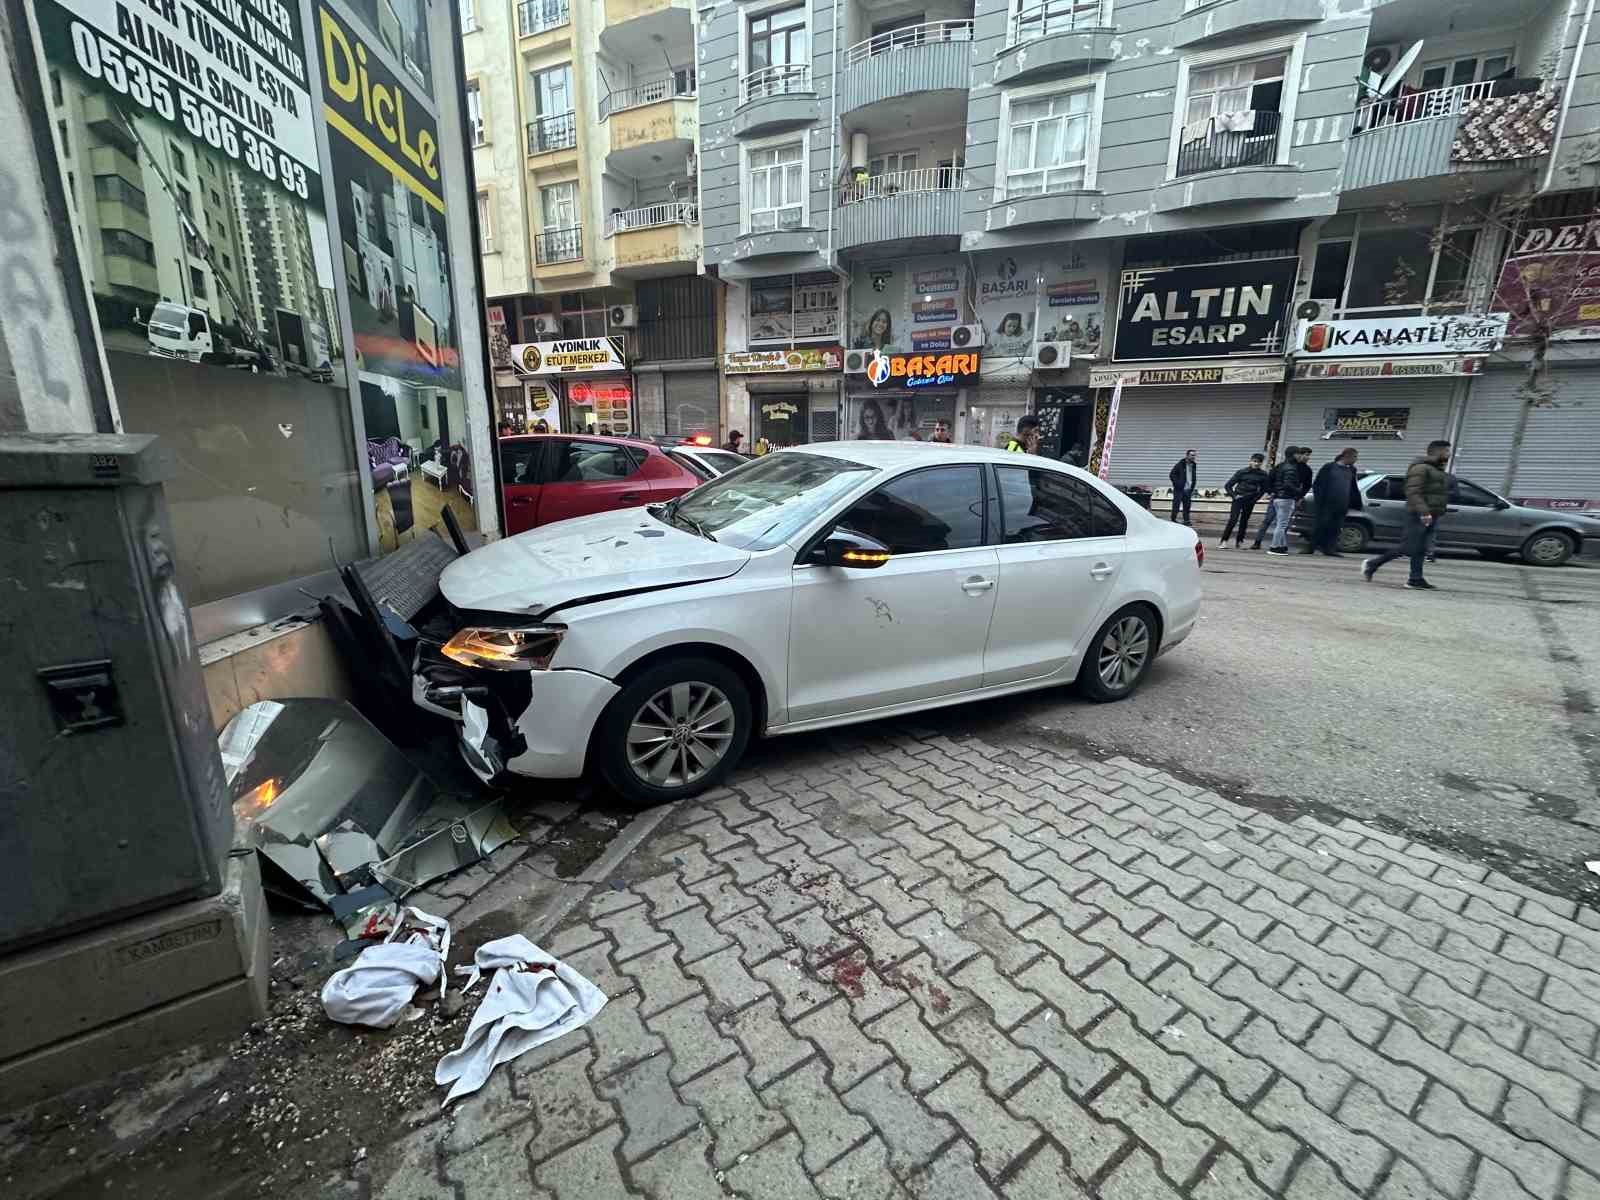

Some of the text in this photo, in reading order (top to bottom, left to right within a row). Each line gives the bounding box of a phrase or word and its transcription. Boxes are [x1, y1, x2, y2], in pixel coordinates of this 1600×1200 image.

[115, 1, 204, 91] ALINIR
[245, 10, 304, 82] YAPILIR
[180, 1, 252, 82] TÜRLÜ
[254, 61, 298, 118] EŞYA
[71, 21, 308, 199] 0535 586 36 93
[982, 280, 1028, 294] BAŞARI
[1131, 285, 1273, 322] ALTIN
[1152, 323, 1246, 346] ESARP
[1334, 326, 1495, 346] KANATLI STORE
[552, 339, 601, 354] AYDINLIK
[891, 354, 978, 377] BAŞARI
[1141, 370, 1178, 383] ALTIN
[1180, 368, 1222, 383] EŞARP
